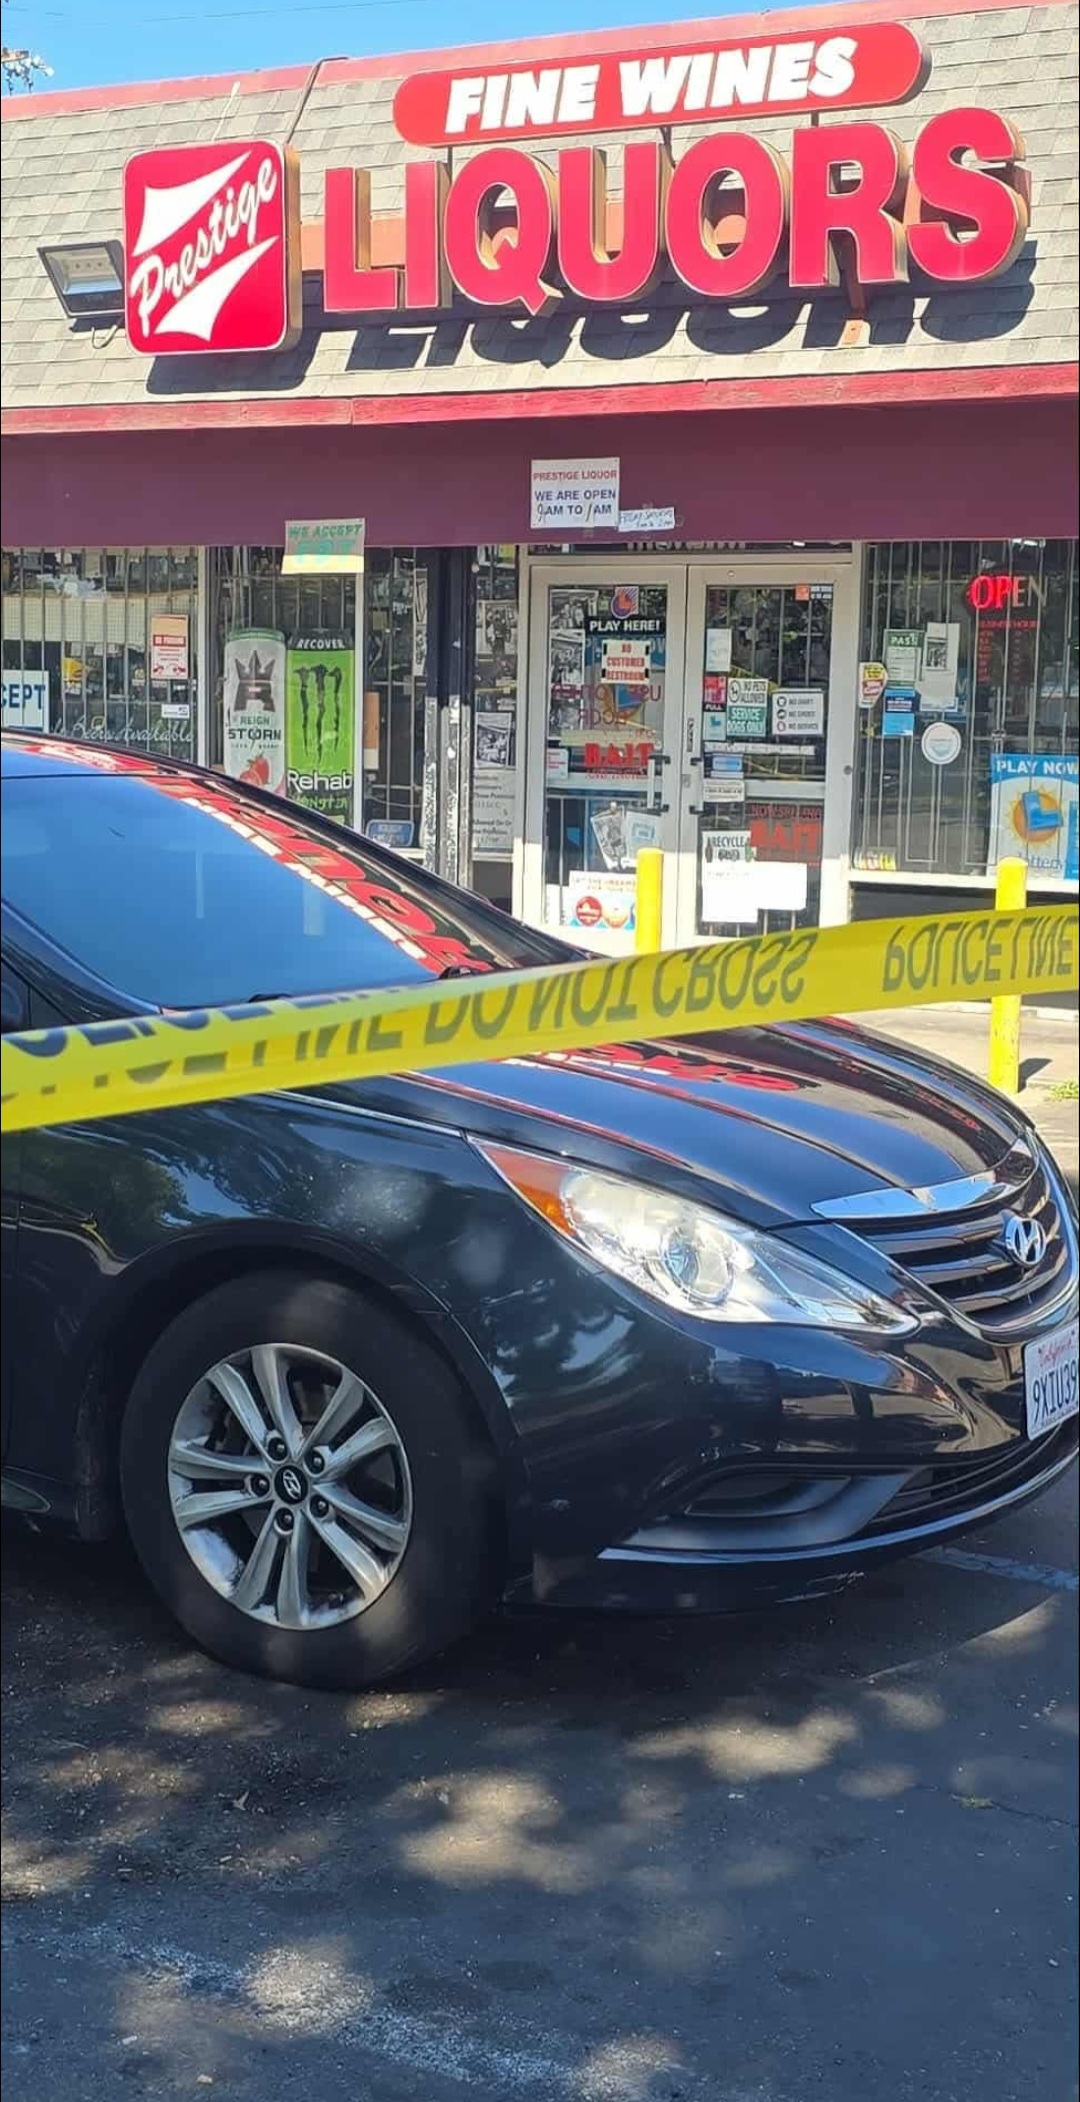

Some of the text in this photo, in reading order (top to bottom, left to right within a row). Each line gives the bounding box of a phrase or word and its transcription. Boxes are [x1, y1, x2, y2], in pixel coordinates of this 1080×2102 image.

[446, 37, 858, 134] FINE WINES
[323, 107, 1027, 316] LIQUORS
[130, 157, 278, 339] Prestige
[533, 470, 617, 482] PRESTIGE LIQUOR
[535, 489, 616, 501] WE ARE OPEN
[567, 505, 583, 515] TO
[312, 524, 363, 536] ACCEPT
[970, 575, 1048, 609] OPEN
[589, 620, 660, 631] PLAY HERE!
[297, 638, 346, 649] RECOVER
[240, 716, 270, 726] REIGN
[584, 742, 655, 767] BAIT
[996, 758, 1079, 776] PLAY NOW
[287, 770, 352, 793] Rehab
[749, 819, 821, 849] BAIT
[711, 836, 745, 848] RECYCLE
